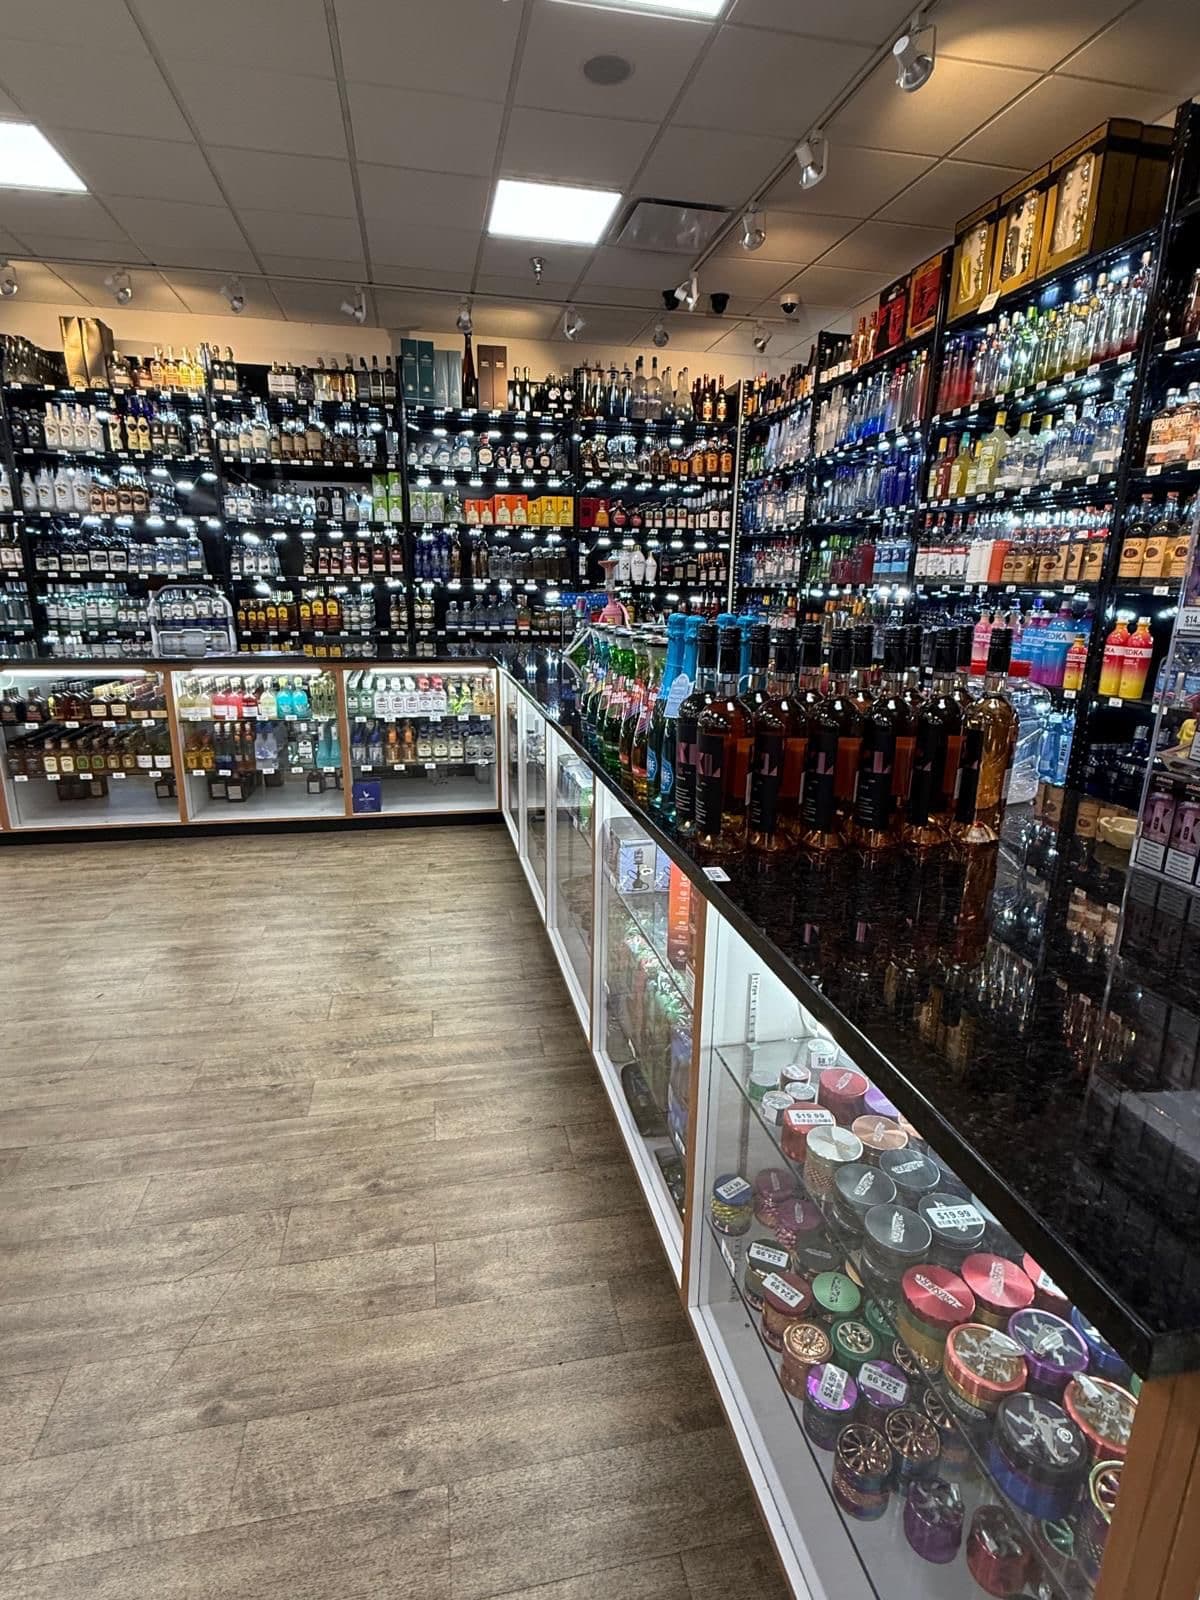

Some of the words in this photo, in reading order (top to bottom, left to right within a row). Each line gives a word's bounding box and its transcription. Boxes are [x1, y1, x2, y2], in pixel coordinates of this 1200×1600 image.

[936, 1210, 971, 1220] $19.99
[756, 1249, 782, 1262] $24.99
[769, 1281, 796, 1301] $24.99
[823, 1372, 838, 1398] $24.99
[867, 1374, 898, 1394] $24.99
